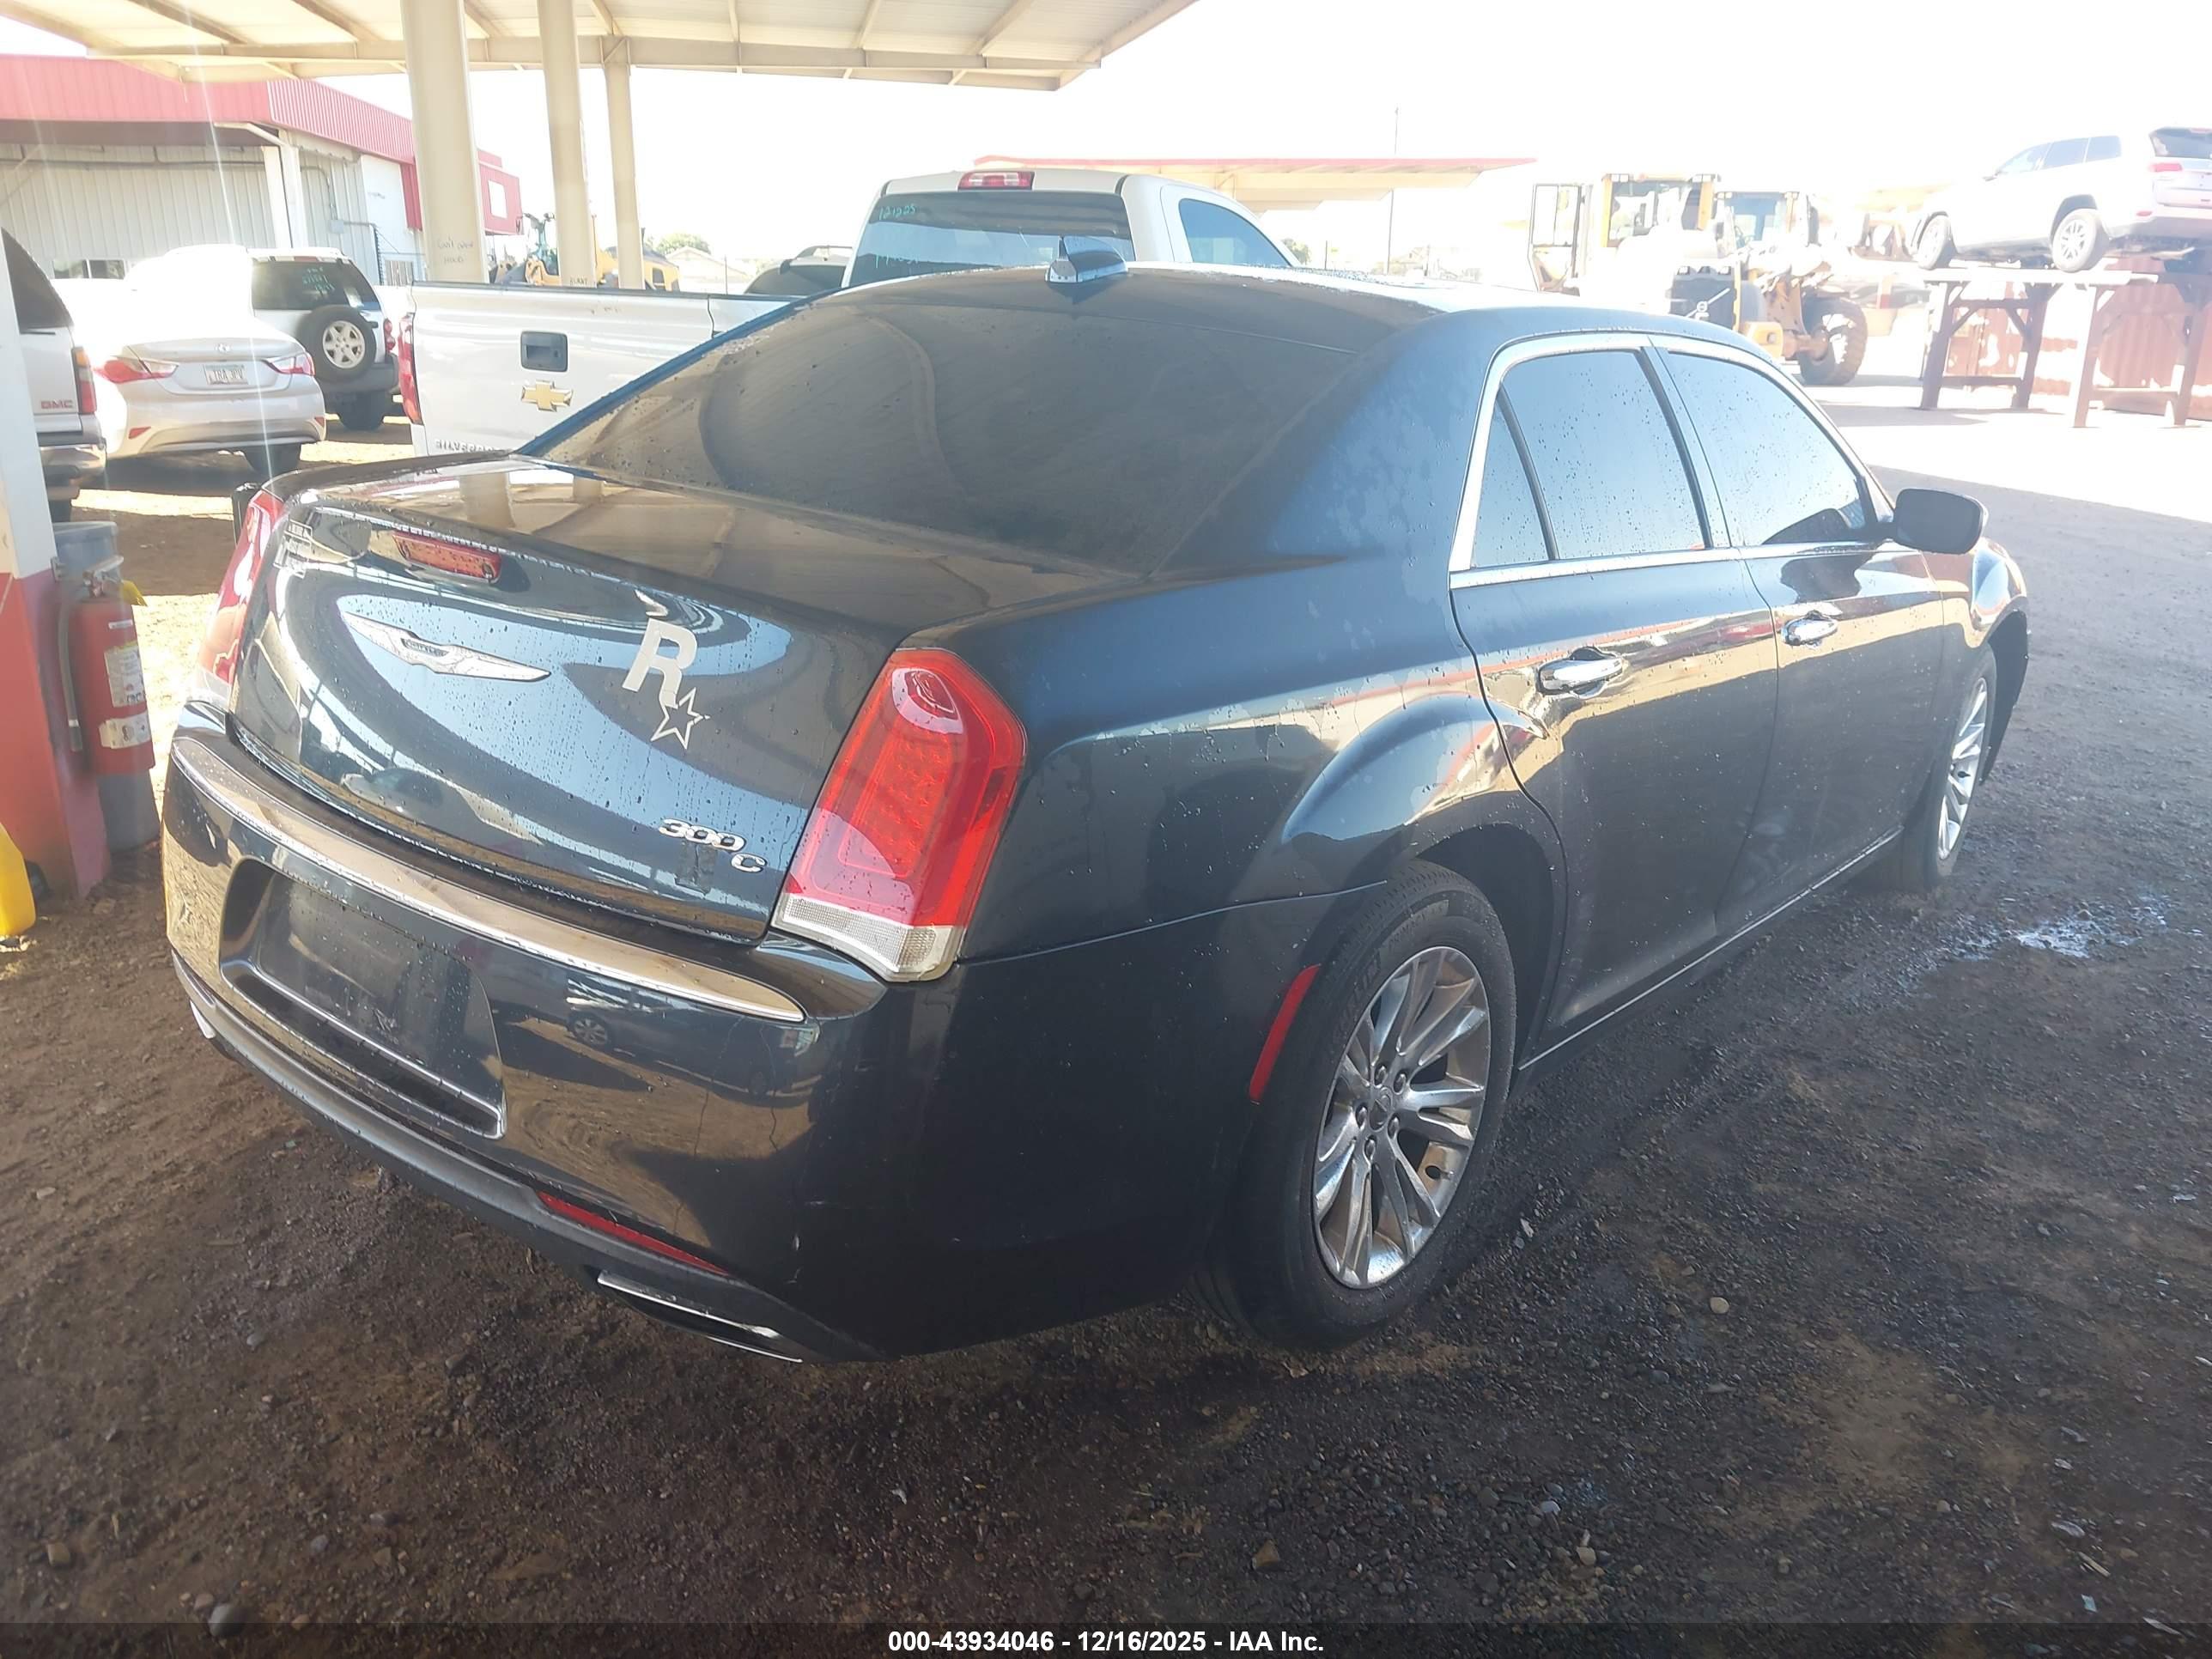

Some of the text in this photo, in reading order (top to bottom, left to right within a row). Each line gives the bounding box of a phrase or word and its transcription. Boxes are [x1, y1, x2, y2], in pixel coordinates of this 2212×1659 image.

[40, 399, 73, 410] GMC
[623, 618, 698, 708] R
[658, 817, 747, 853] 300
